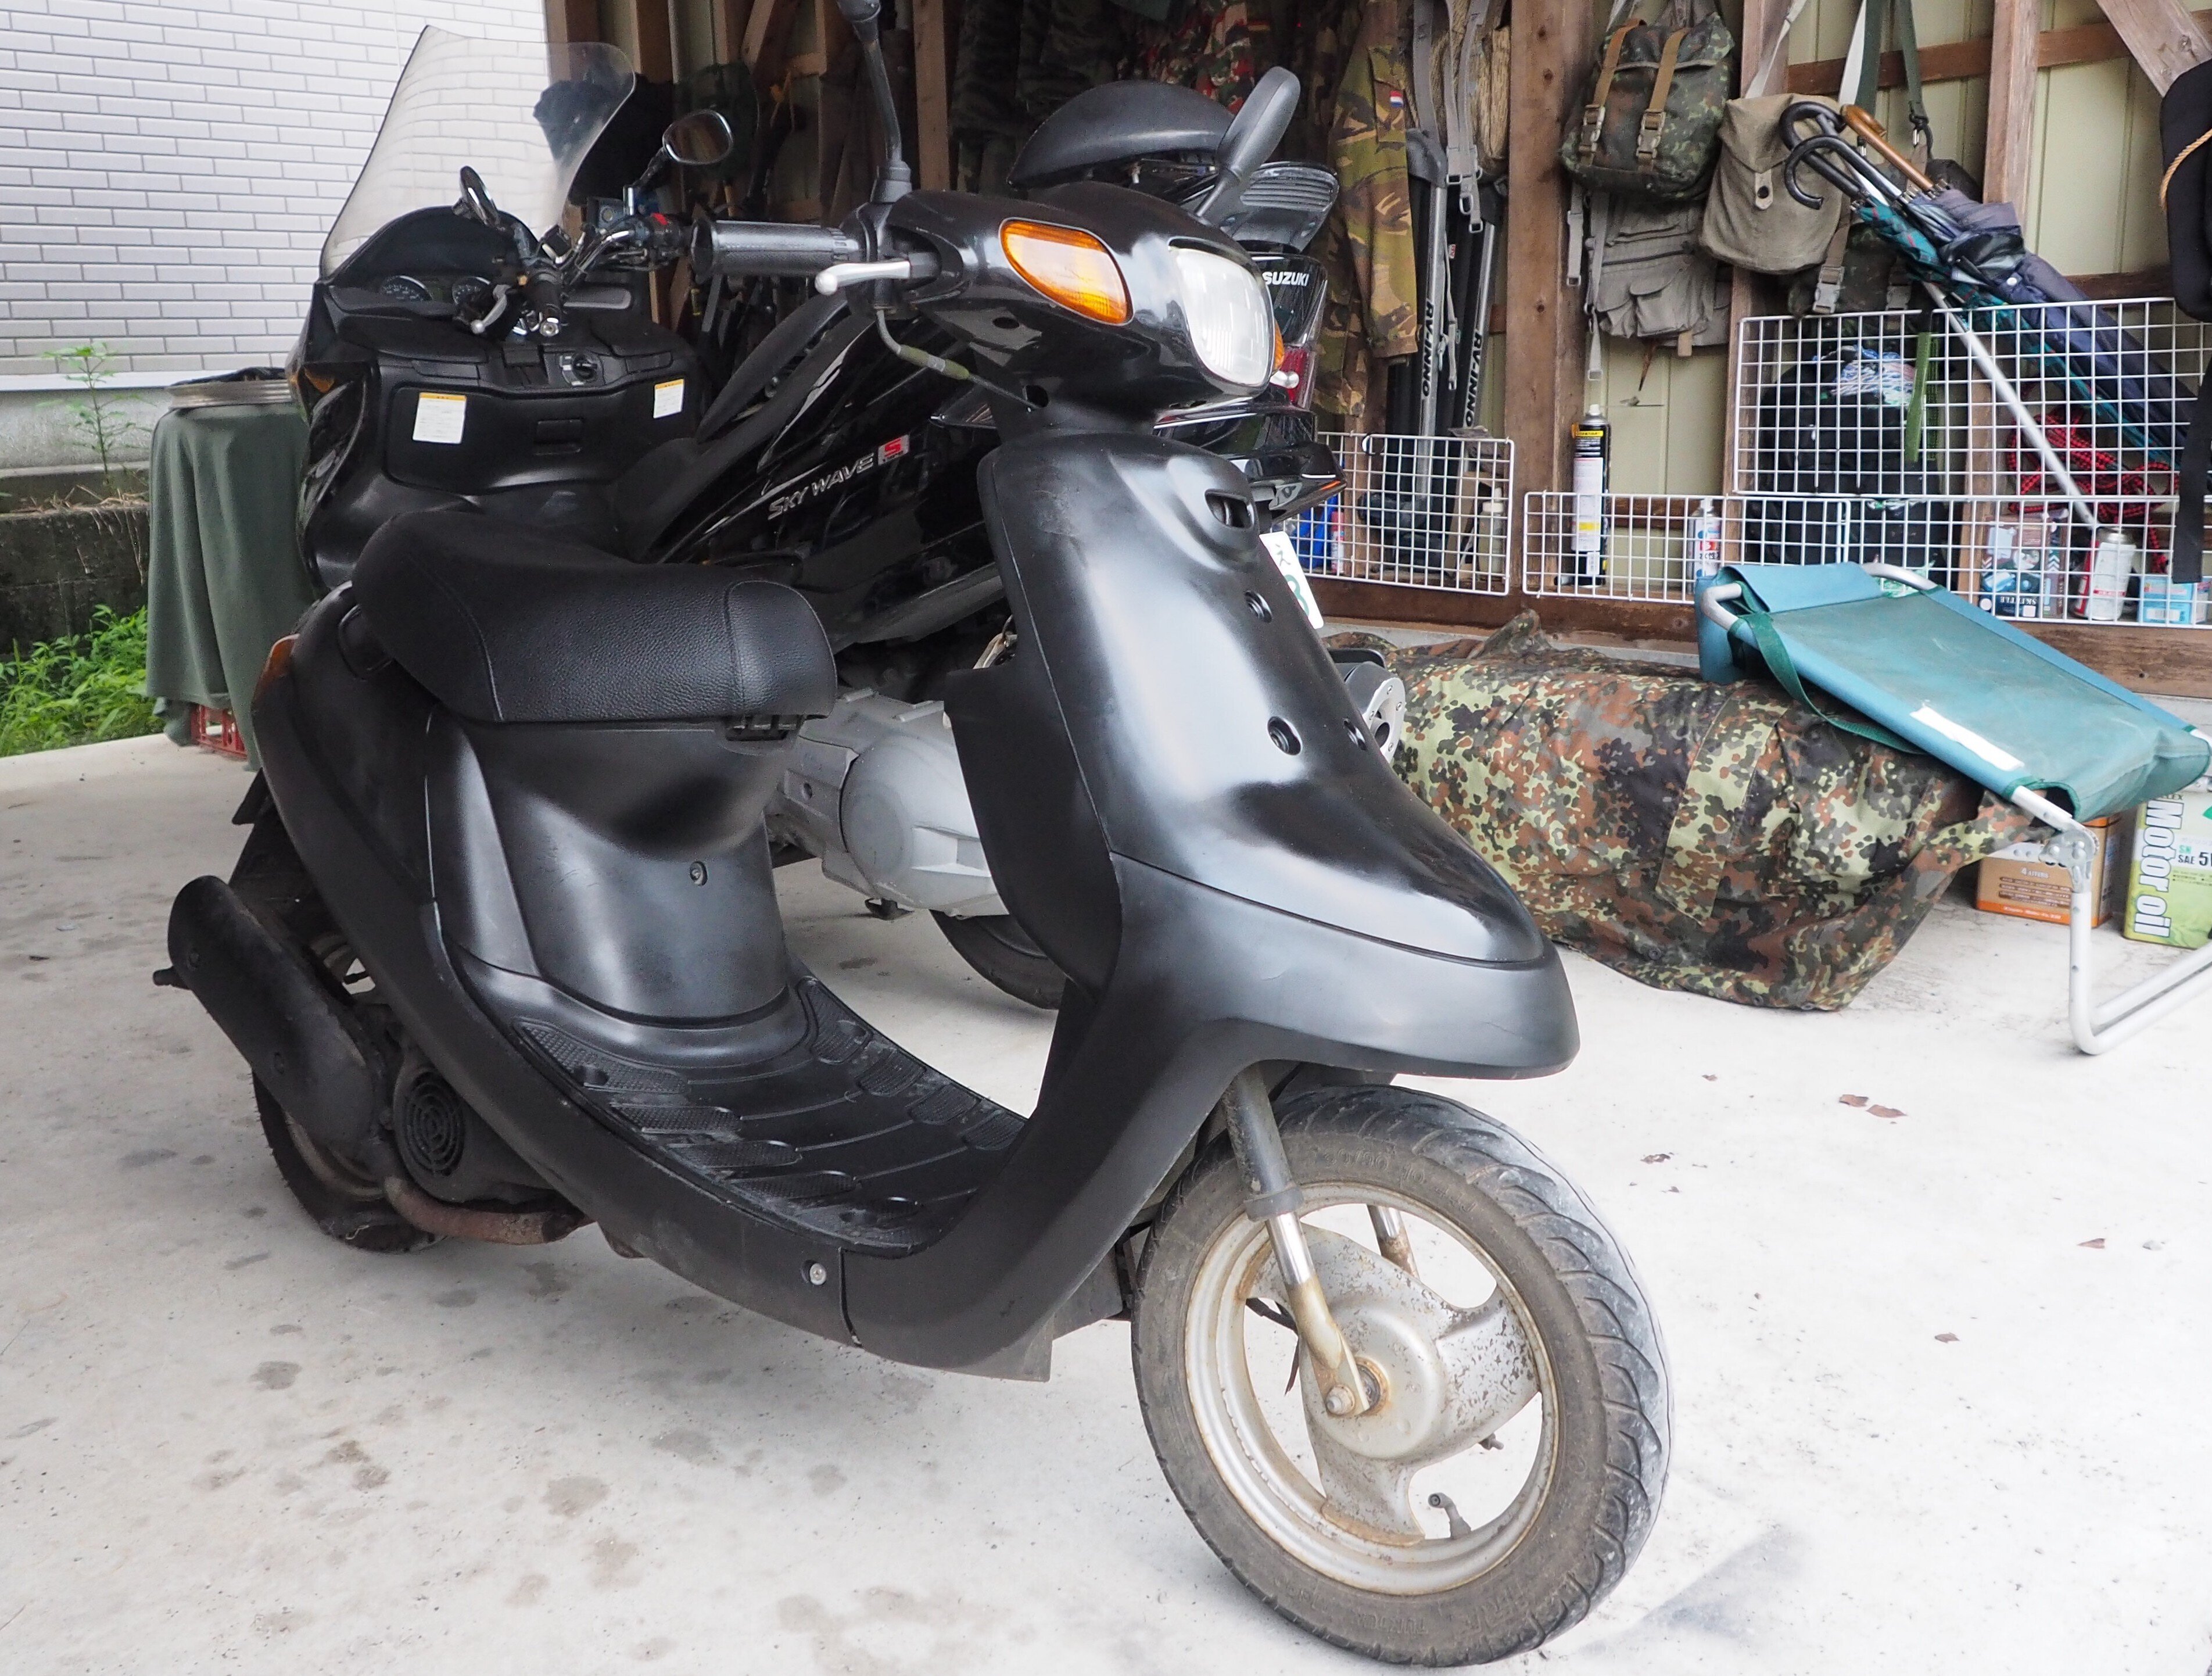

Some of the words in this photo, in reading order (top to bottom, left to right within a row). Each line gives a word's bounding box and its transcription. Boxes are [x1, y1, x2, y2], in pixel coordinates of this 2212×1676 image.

[1262, 271, 1310, 287] SUZUKI
[1422, 300, 1435, 397] RV-INNO
[1465, 332, 1482, 427] RV-INNO
[768, 486, 809, 521] SKY
[811, 452, 874, 497] WAVE
[2139, 799, 2185, 893] Motor
[2178, 854, 2195, 865] SAE
[2199, 851, 2212, 867] 5
[2134, 894, 2172, 938] oil
